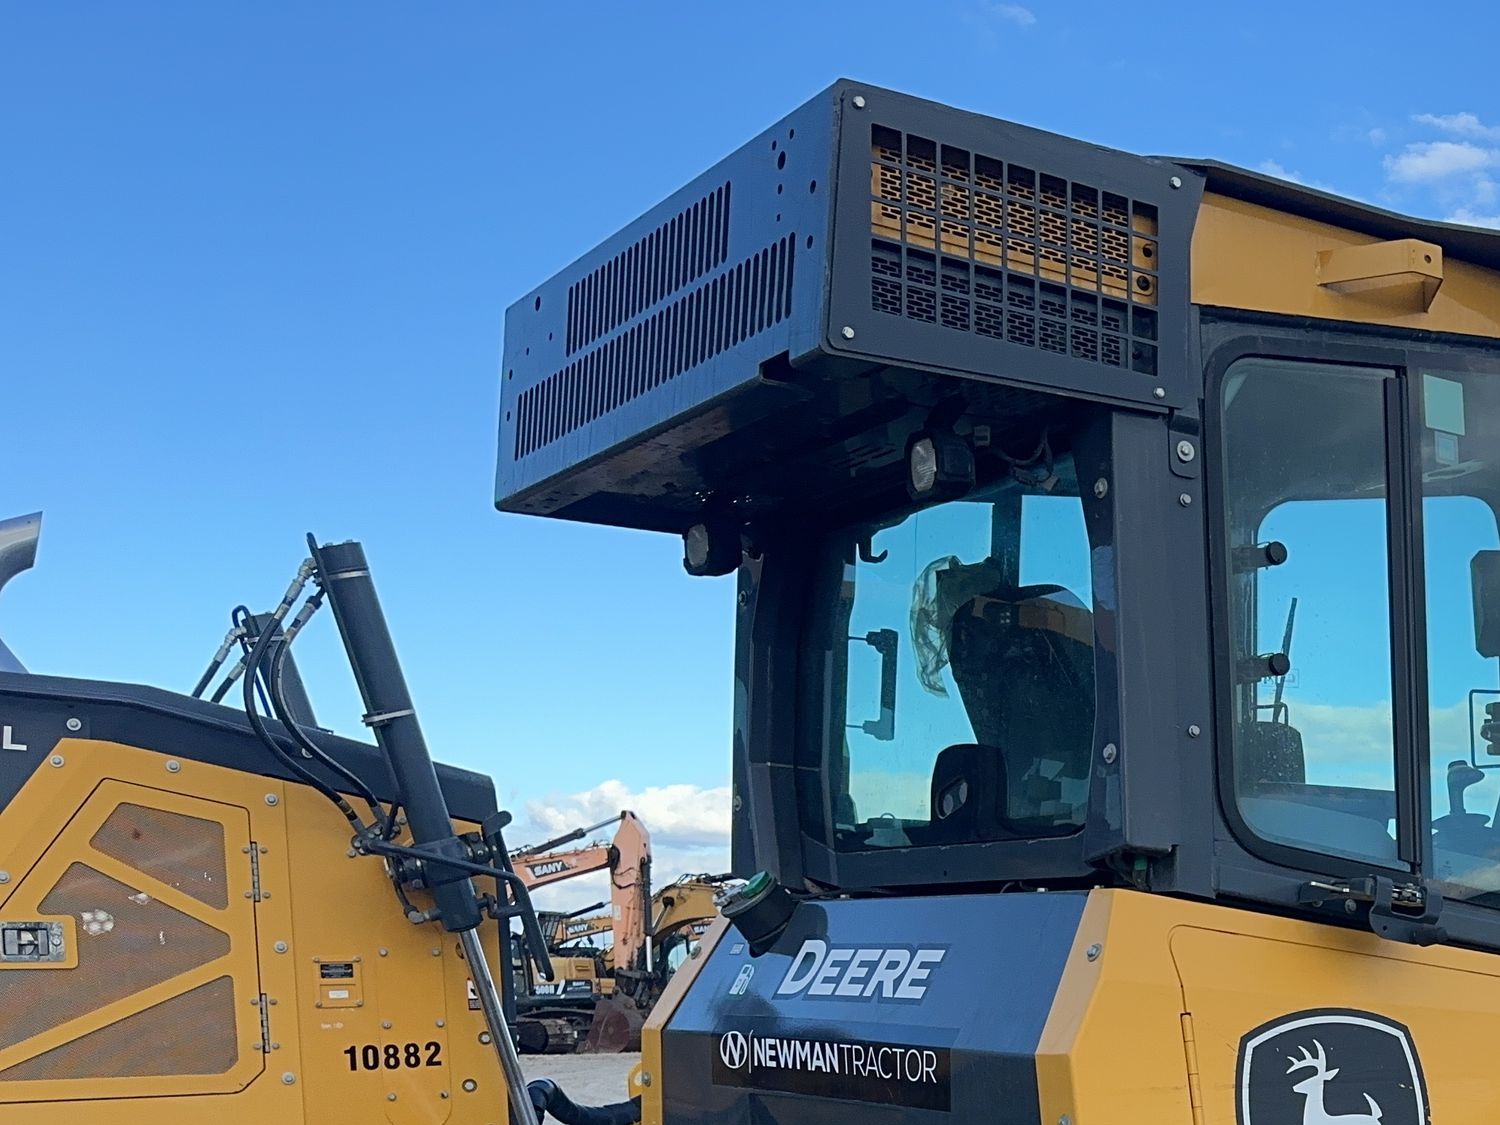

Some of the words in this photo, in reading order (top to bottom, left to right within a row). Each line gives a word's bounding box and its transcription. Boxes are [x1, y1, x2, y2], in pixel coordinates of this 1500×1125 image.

[533, 861, 562, 877] SANY
[777, 939, 946, 999] DEERE
[343, 1041, 443, 1072] 10882
